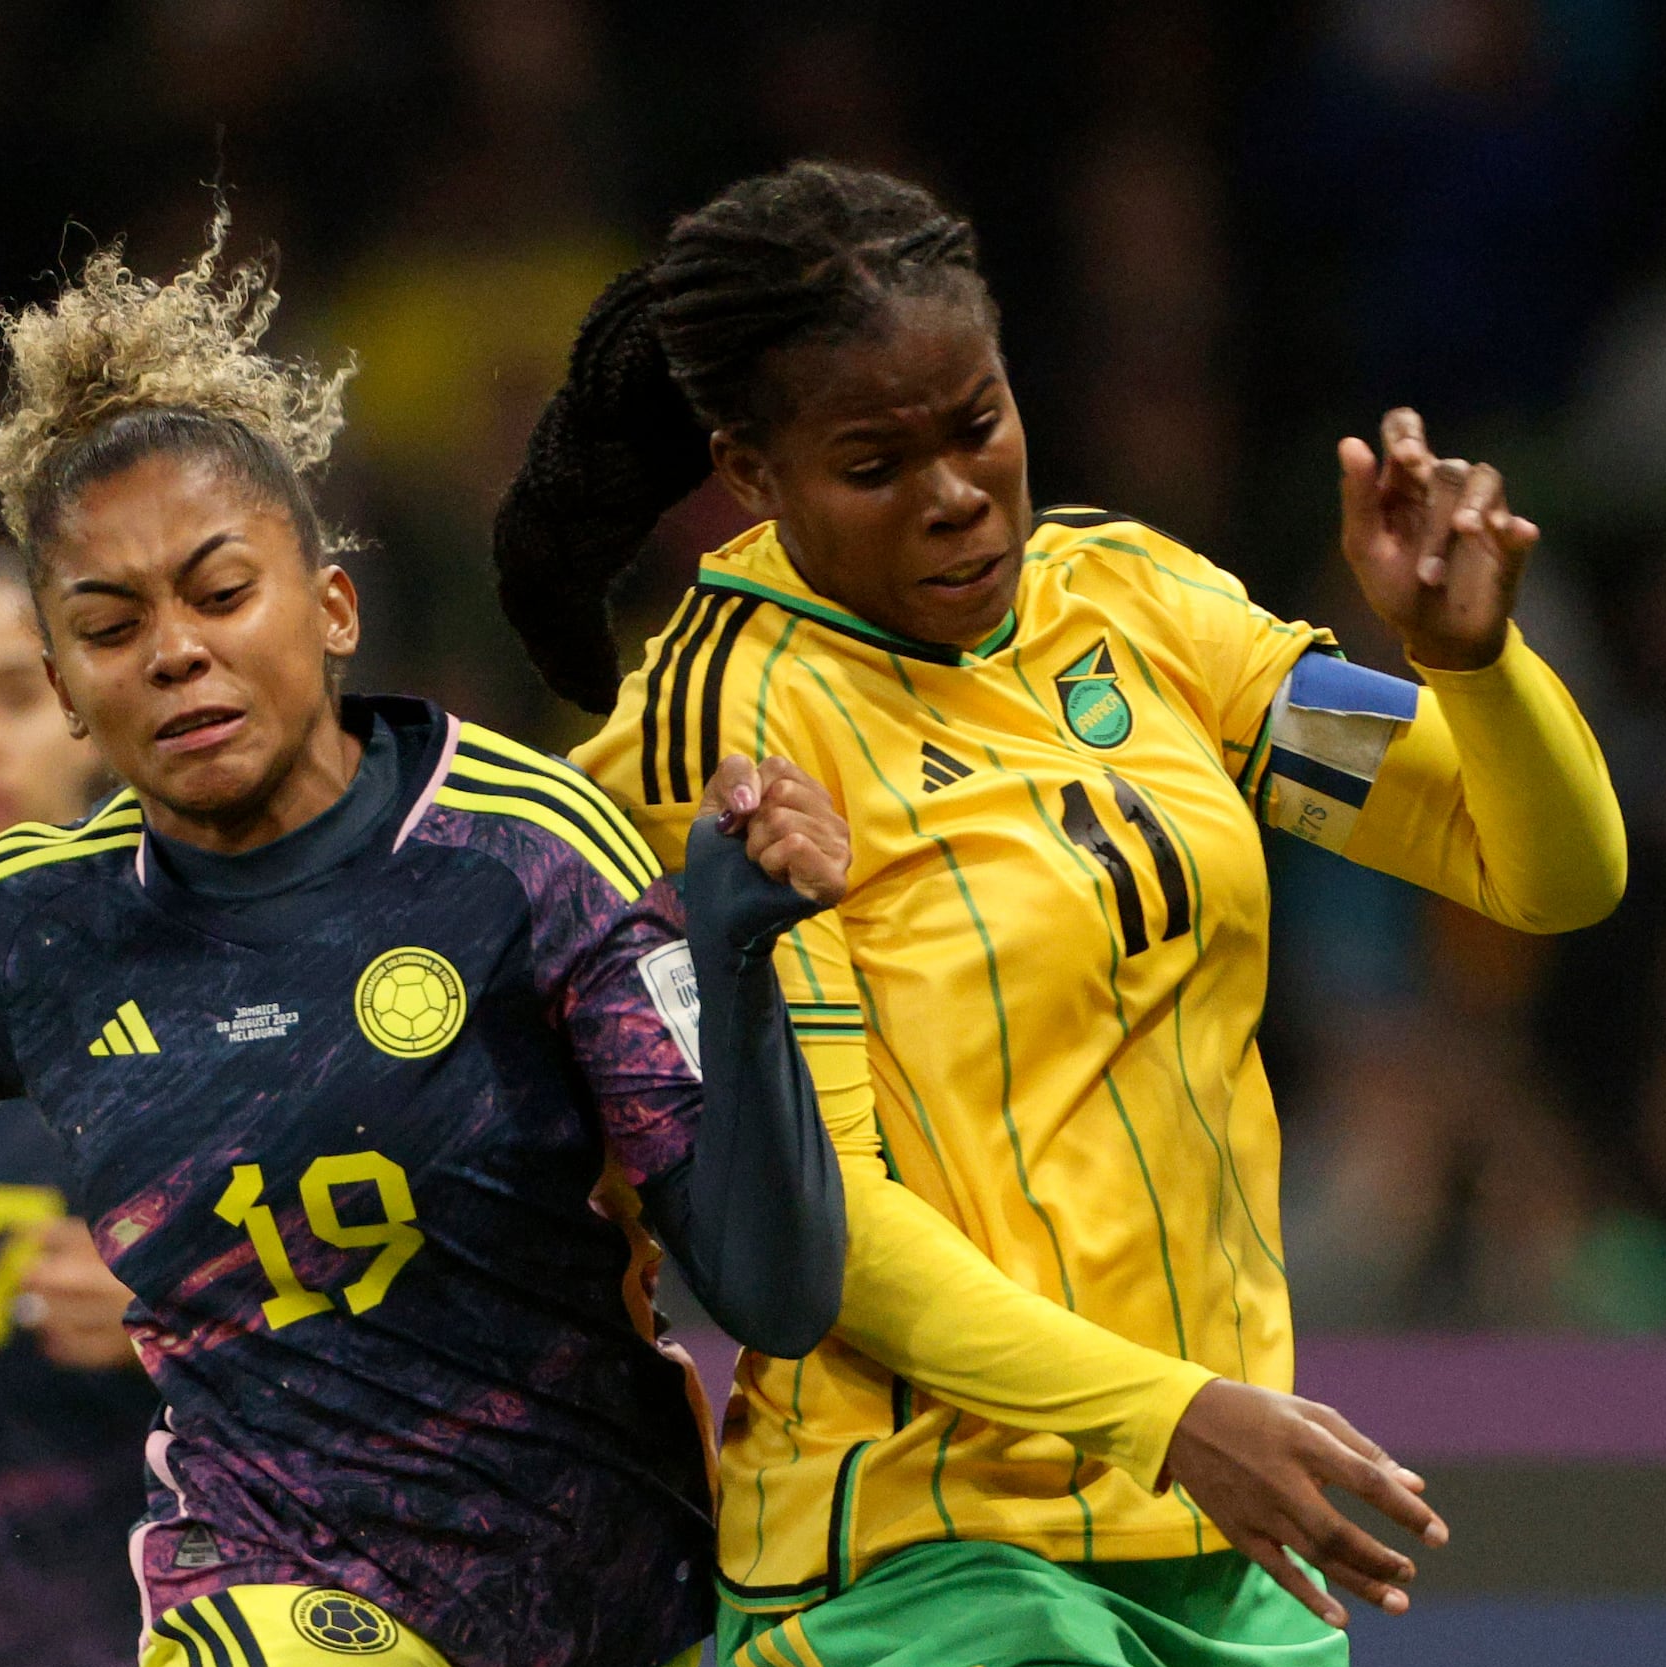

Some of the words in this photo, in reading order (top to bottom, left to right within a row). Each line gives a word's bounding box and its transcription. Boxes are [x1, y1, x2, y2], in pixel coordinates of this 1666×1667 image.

[1060, 773, 1191, 958] 11
[216, 1021, 231, 1033] 08
[232, 1016, 270, 1030] AUGUST
[272, 1011, 299, 1026] 2023
[235, 1003, 280, 1019] JAMAICA
[228, 1024, 288, 1043] MELBOURNE
[213, 1150, 425, 1331] 19
